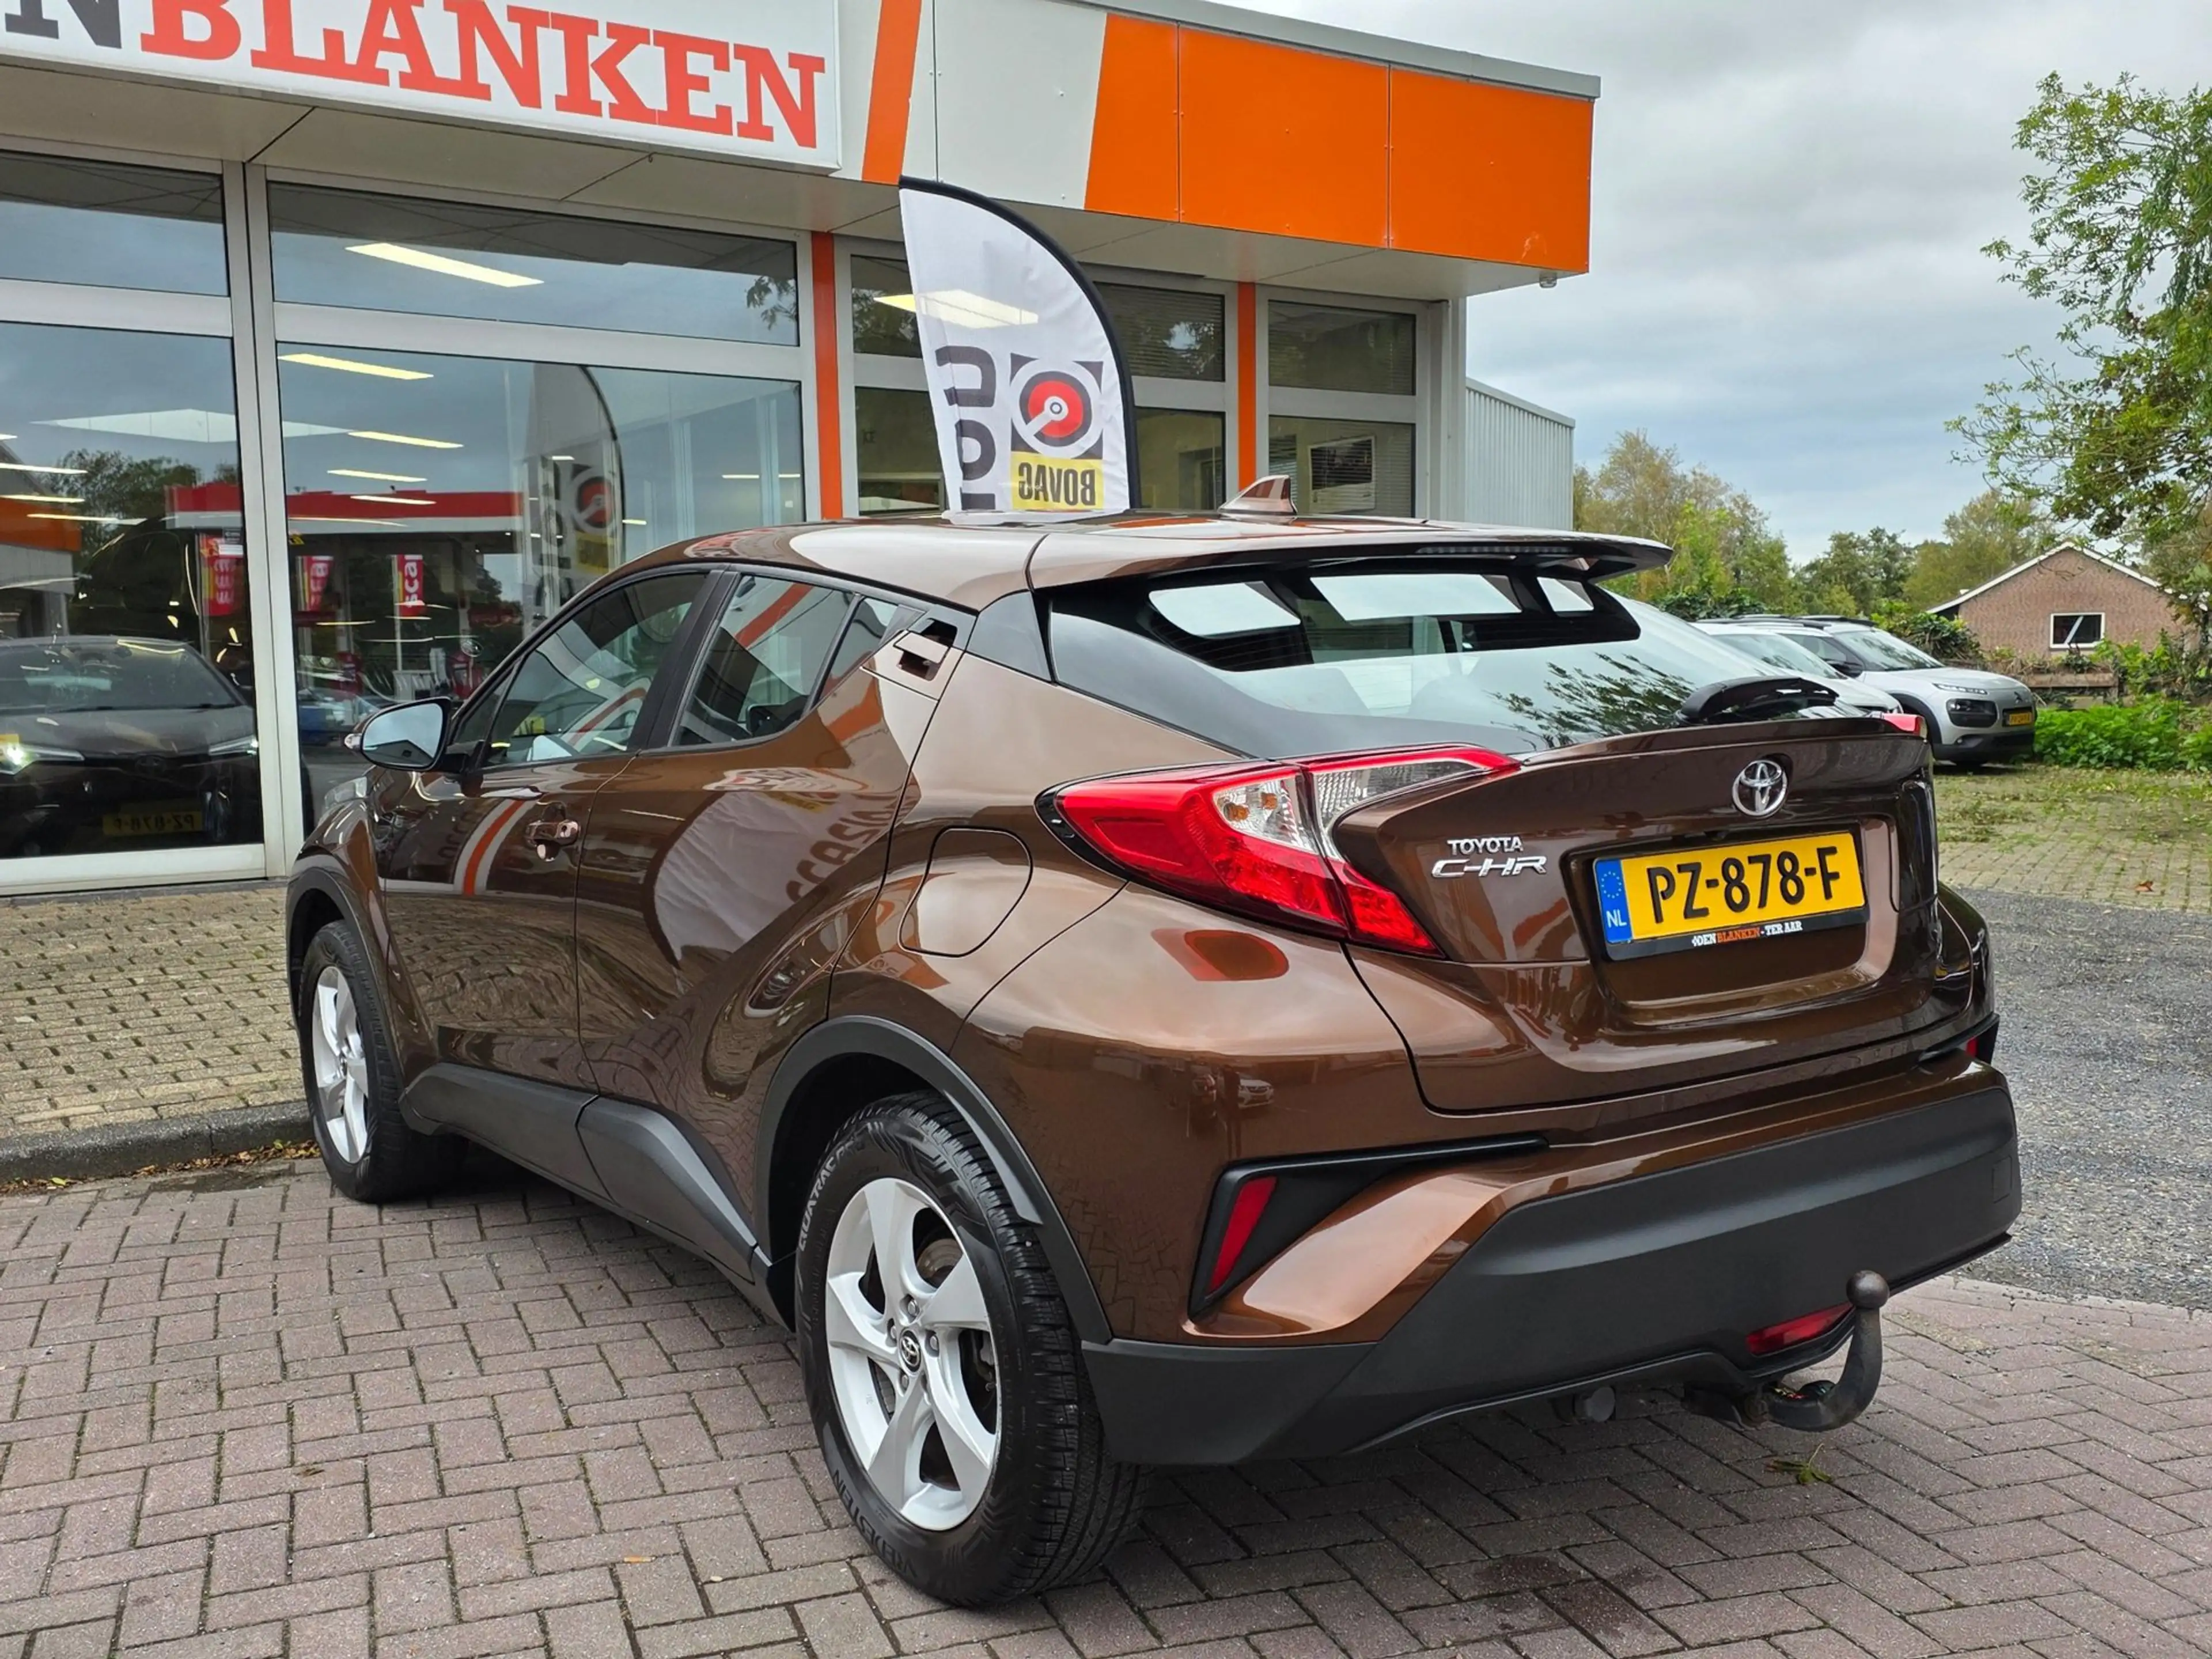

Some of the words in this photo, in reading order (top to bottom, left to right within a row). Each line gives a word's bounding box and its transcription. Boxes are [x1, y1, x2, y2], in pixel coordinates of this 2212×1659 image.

[140, 0, 825, 149] BLANKEN
[1446, 836, 1524, 856] TOYOTA
[1431, 856, 1547, 878] C-HR
[1646, 846, 1840, 924] PZ-878-F
[1606, 910, 1627, 928] NL
[1717, 927, 1760, 943] BLANKEN
[1764, 923, 1784, 935] TER
[1784, 920, 1804, 933] AAR
